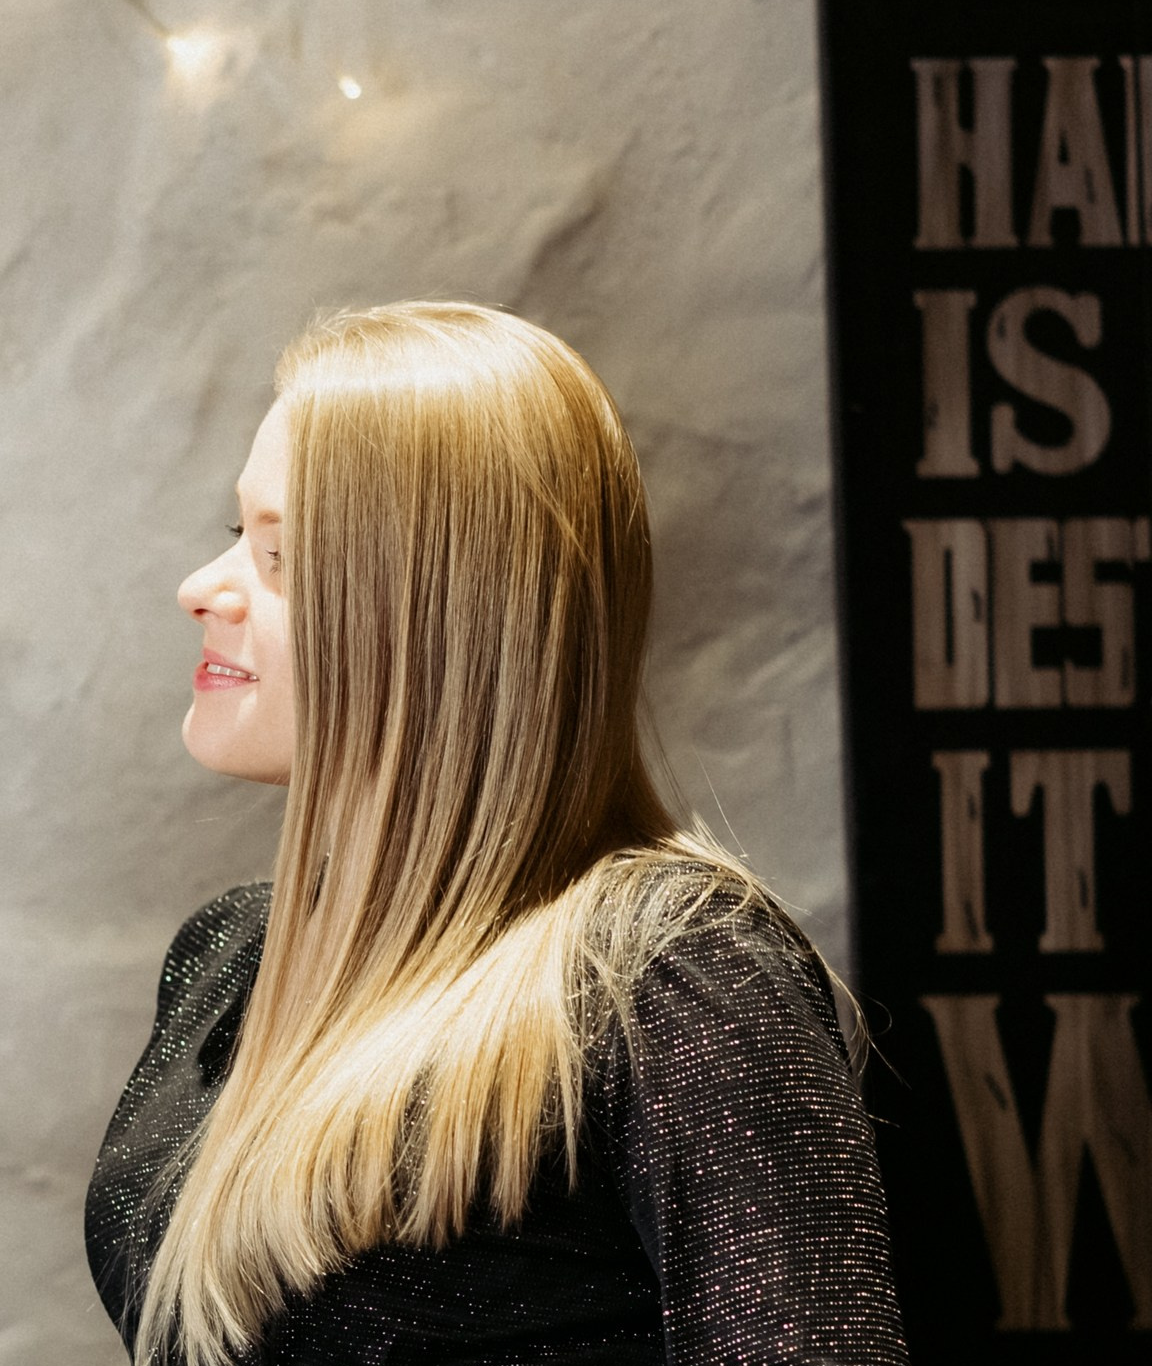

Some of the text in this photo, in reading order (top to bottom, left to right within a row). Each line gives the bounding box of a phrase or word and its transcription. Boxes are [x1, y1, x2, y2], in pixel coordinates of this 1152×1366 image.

[913, 285, 1112, 478] IS
[901, 514, 1152, 712] DES
[932, 749, 1133, 953] IT
